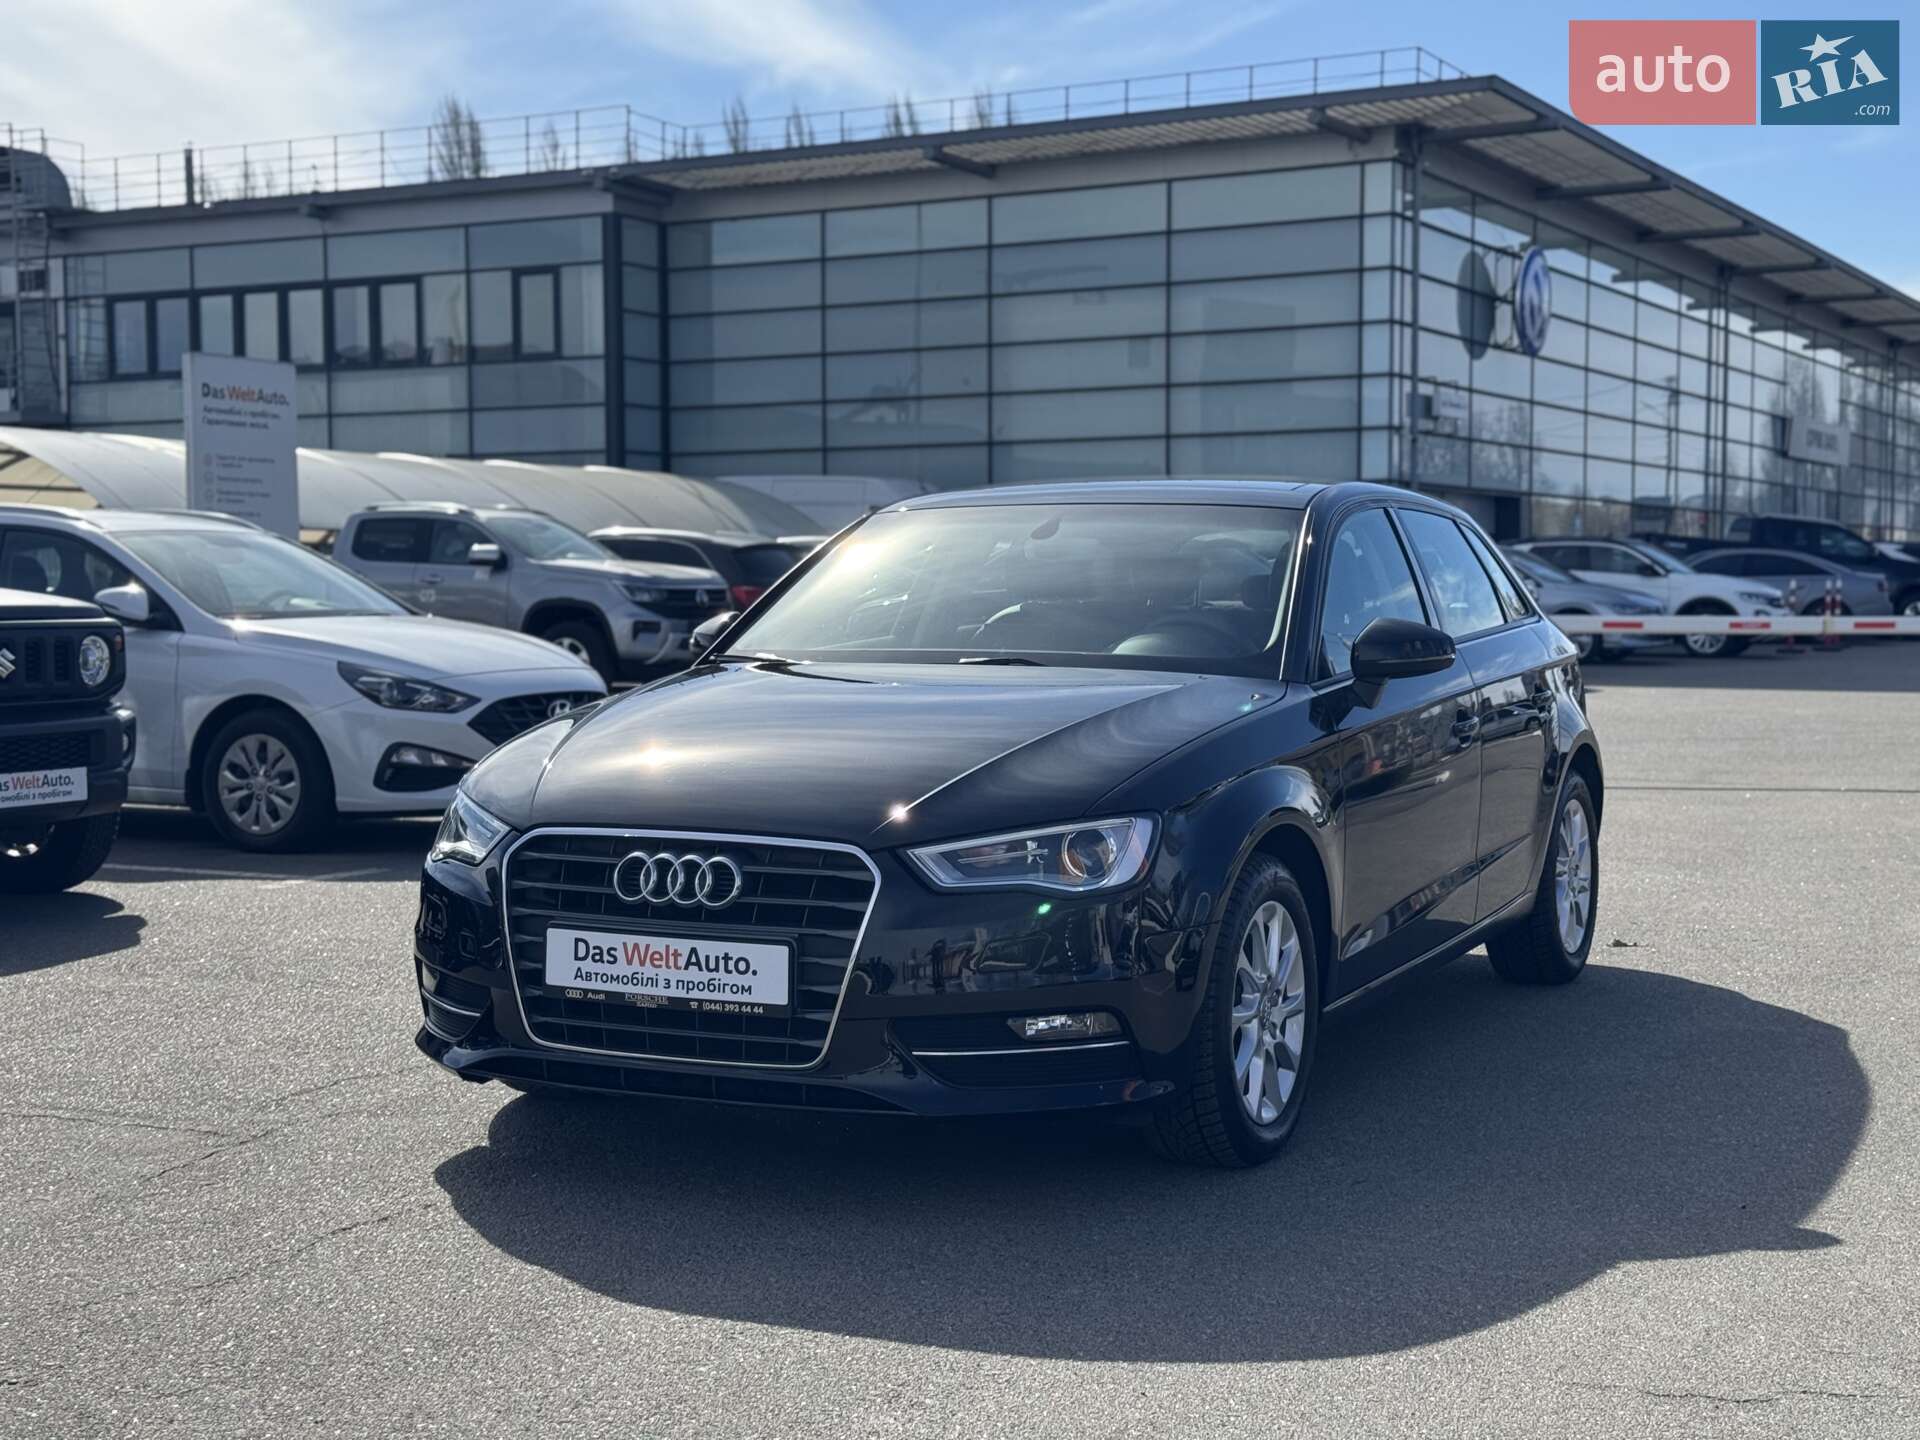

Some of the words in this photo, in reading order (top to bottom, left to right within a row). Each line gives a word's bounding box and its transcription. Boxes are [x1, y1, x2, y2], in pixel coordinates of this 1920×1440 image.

[573, 966, 659, 989] Автомобілі
[663, 978, 671, 990] з
[675, 976, 753, 997] пробігом
[587, 991, 606, 1001] Audi
[702, 1002, 723, 1013] (044)
[724, 1004, 740, 1013] 393
[740, 1005, 752, 1014] 44
[752, 1005, 764, 1015] 44
